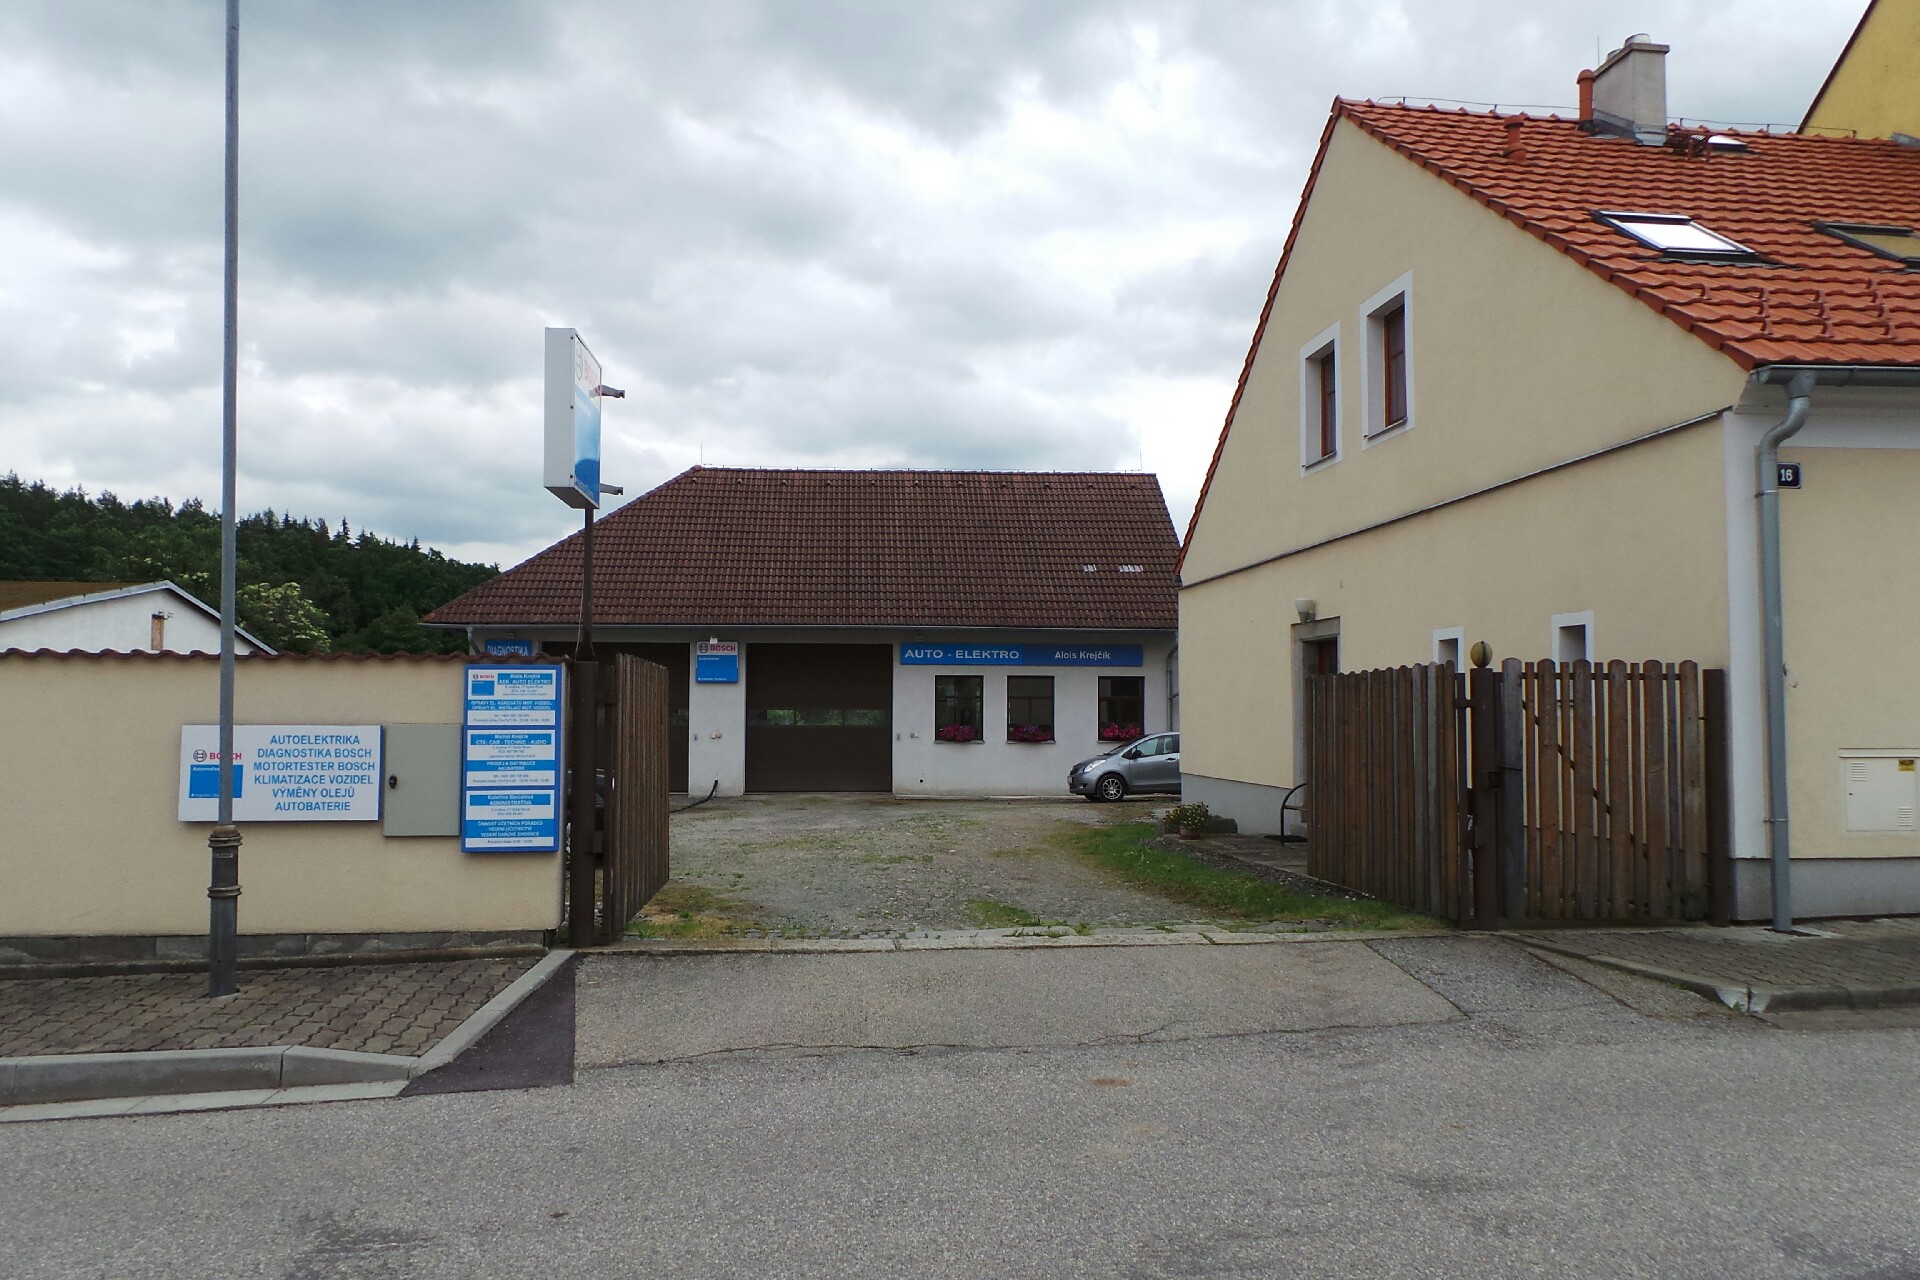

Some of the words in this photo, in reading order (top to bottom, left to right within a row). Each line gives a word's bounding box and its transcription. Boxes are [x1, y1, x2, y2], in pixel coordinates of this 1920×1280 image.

[1780, 469, 1793, 481] 16
[904, 649, 944, 658] AUTO
[955, 650, 1020, 659] ELEKTRO
[1054, 650, 1077, 659] Alois
[1080, 650, 1111, 660] Krejčík
[270, 734, 360, 744] AUTOELEKTRIKA
[257, 748, 332, 758] DIAGNOSTIKA
[334, 748, 372, 758] BOSCH
[253, 762, 335, 771] MOTORTESTER
[338, 762, 375, 771] BOSCH
[254, 774, 326, 784] KLIMATIZACE
[328, 774, 374, 784] VOZIDEL
[272, 786, 318, 798] VÝMĚNY
[320, 786, 355, 798] OLEJŮ
[274, 802, 351, 811] AUTOBATERIE
